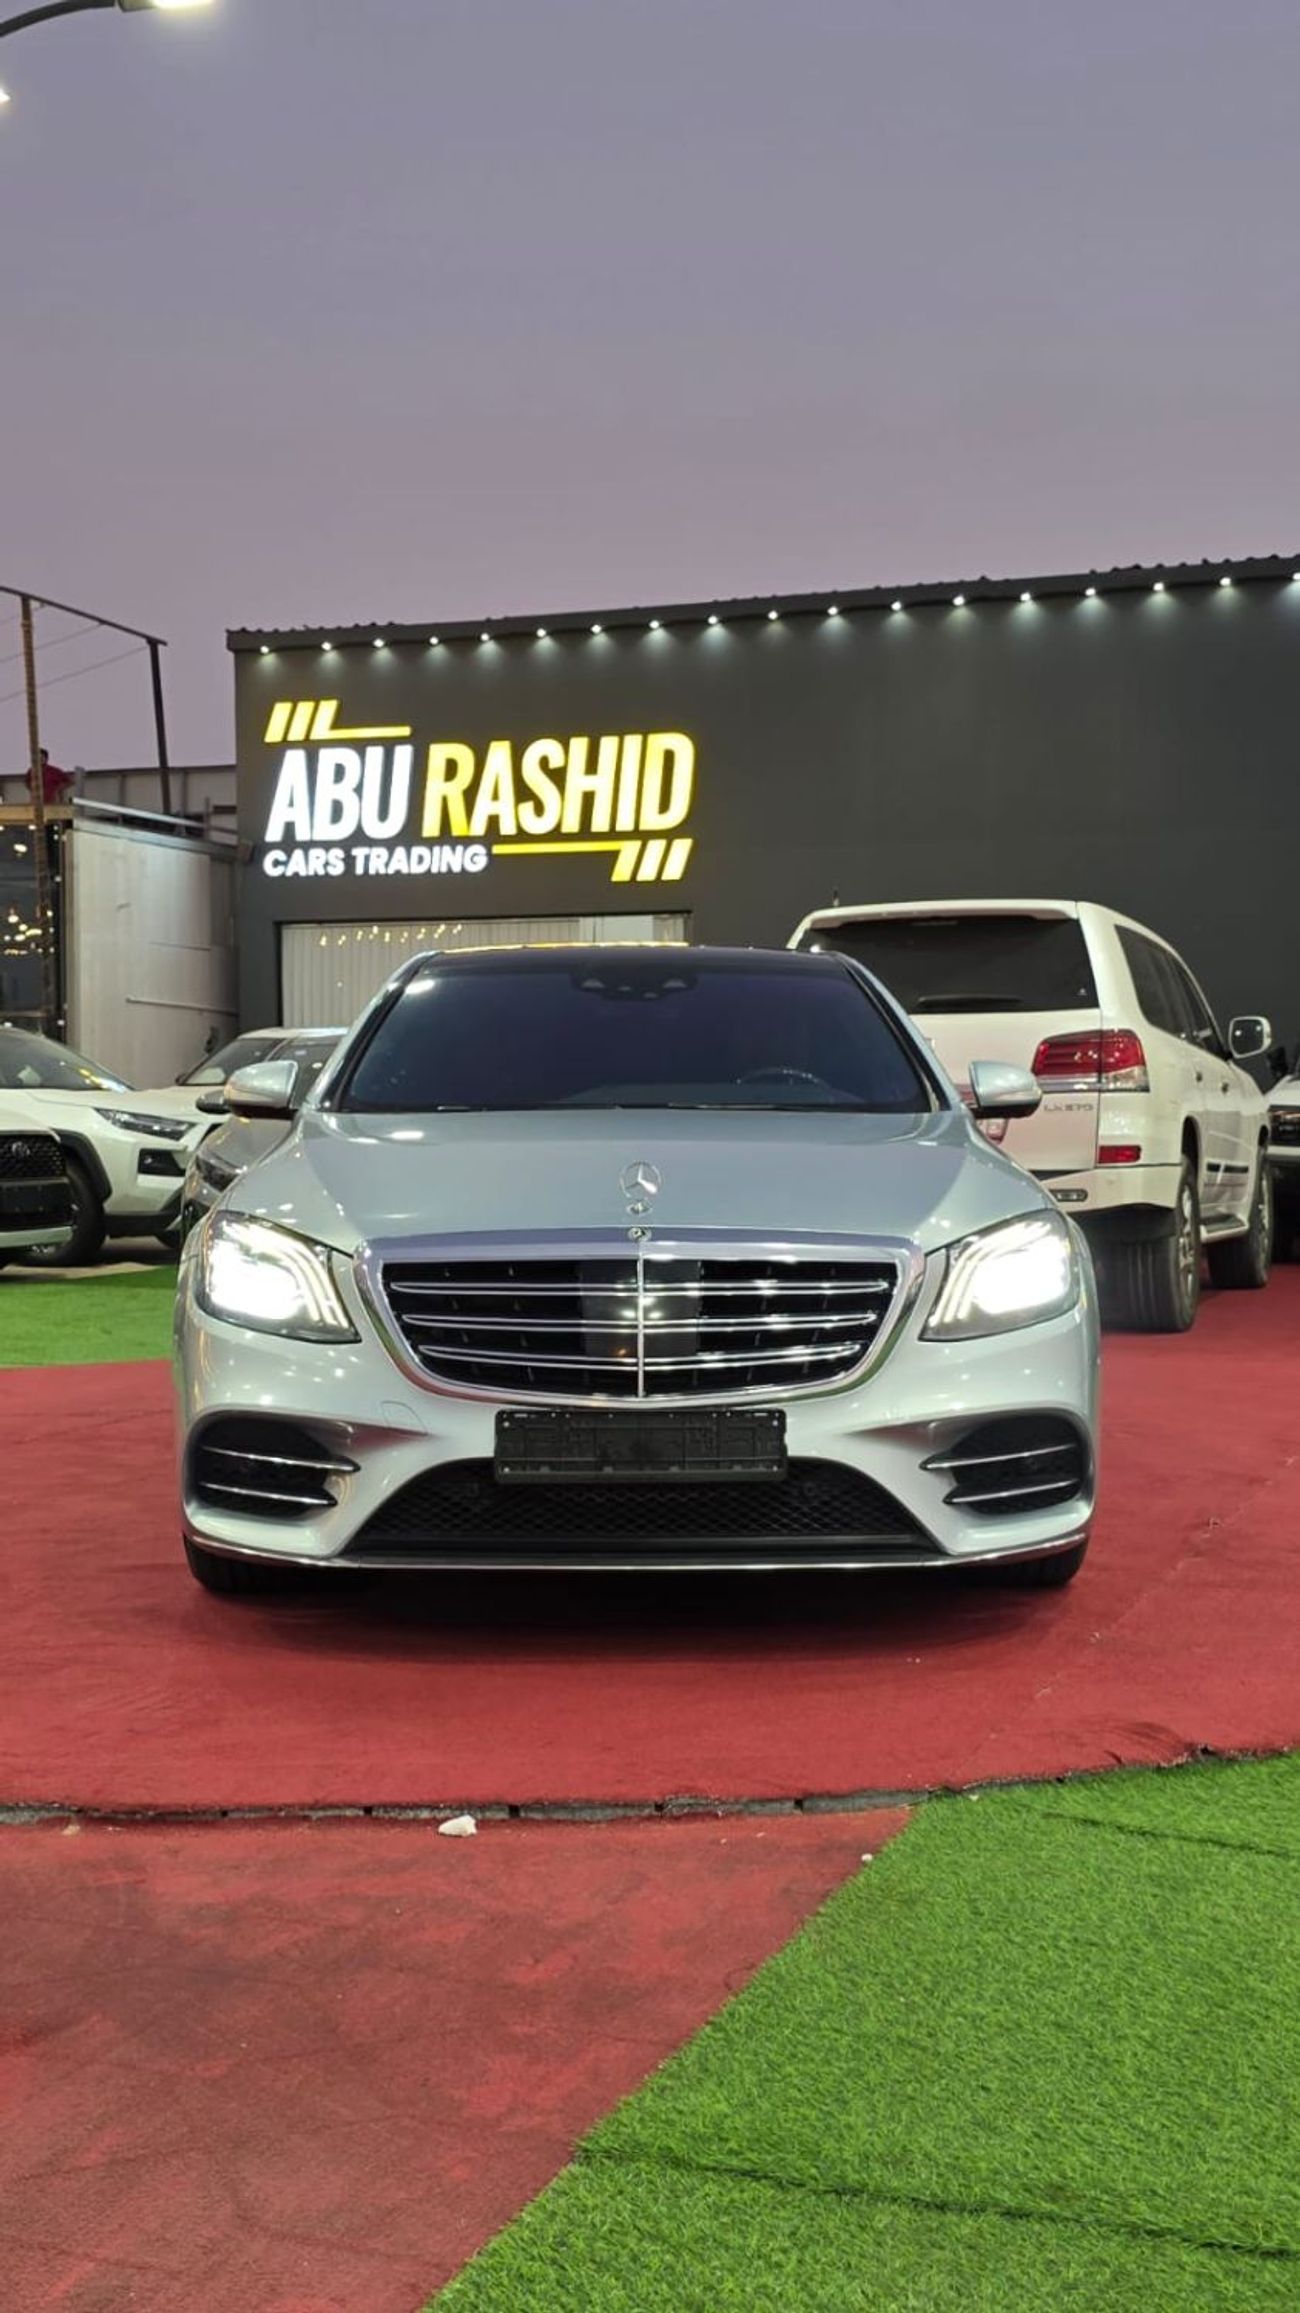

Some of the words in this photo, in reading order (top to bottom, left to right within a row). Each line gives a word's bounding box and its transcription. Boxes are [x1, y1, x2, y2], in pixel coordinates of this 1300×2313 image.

[264, 745, 413, 842] ABU
[422, 733, 694, 838] RASHID
[264, 847, 344, 876] CARS
[353, 844, 488, 875] TRADING
